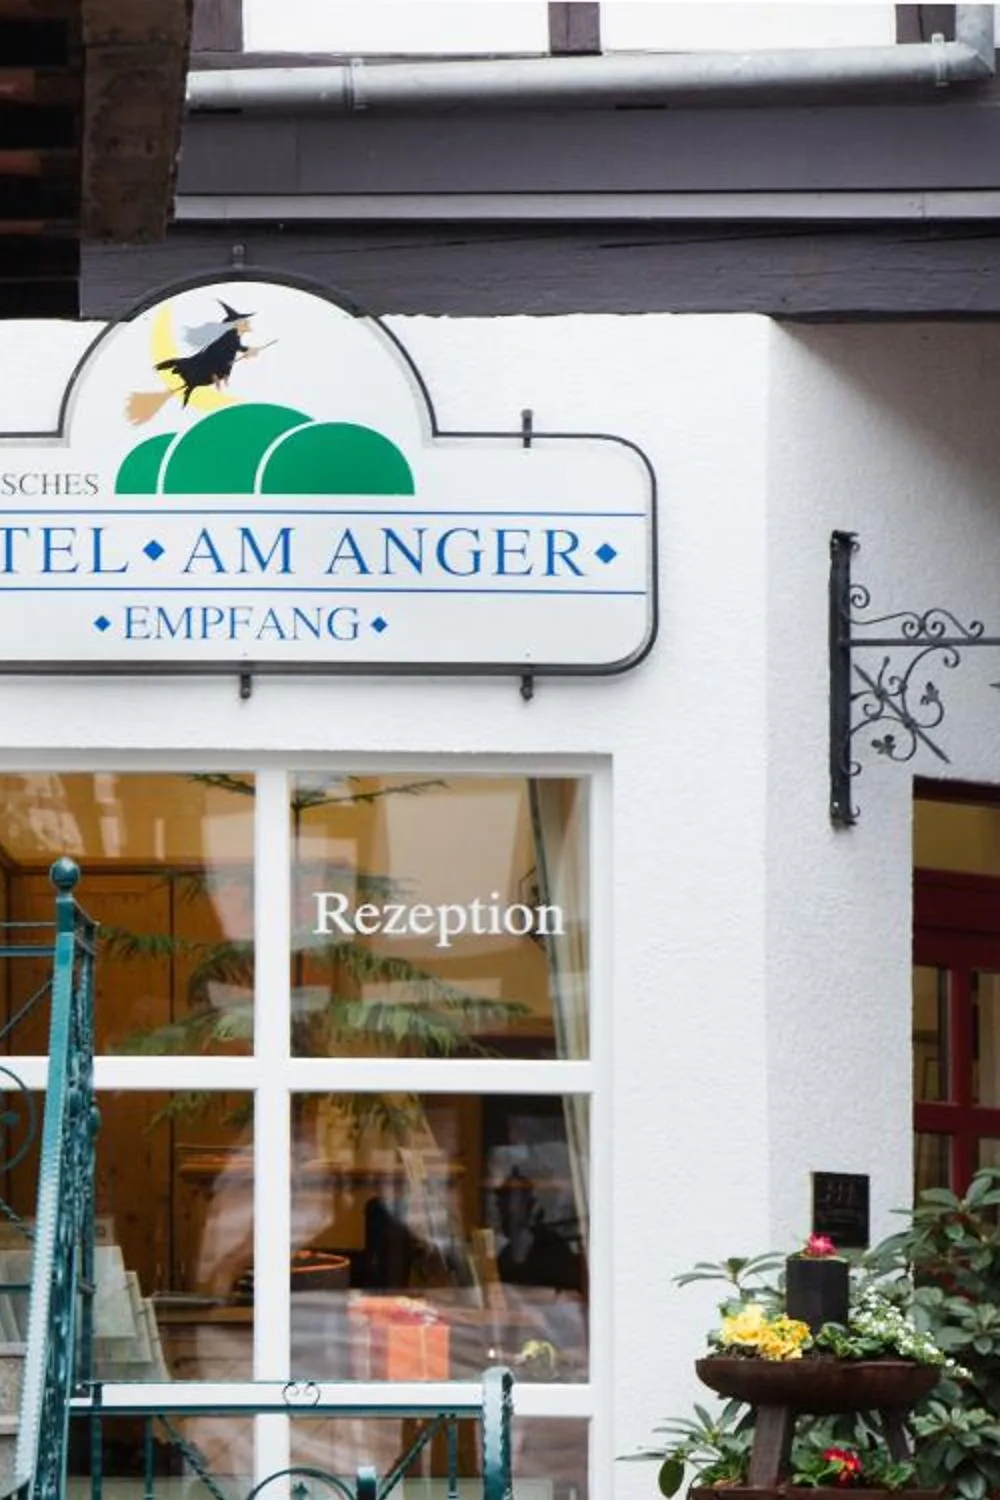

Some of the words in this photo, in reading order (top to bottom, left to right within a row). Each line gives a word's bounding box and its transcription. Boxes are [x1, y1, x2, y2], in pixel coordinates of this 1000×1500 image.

[183, 526, 295, 577] AM
[326, 527, 587, 579] ANGER
[123, 605, 361, 641] EMPFANG
[311, 892, 565, 948] Rezeption
